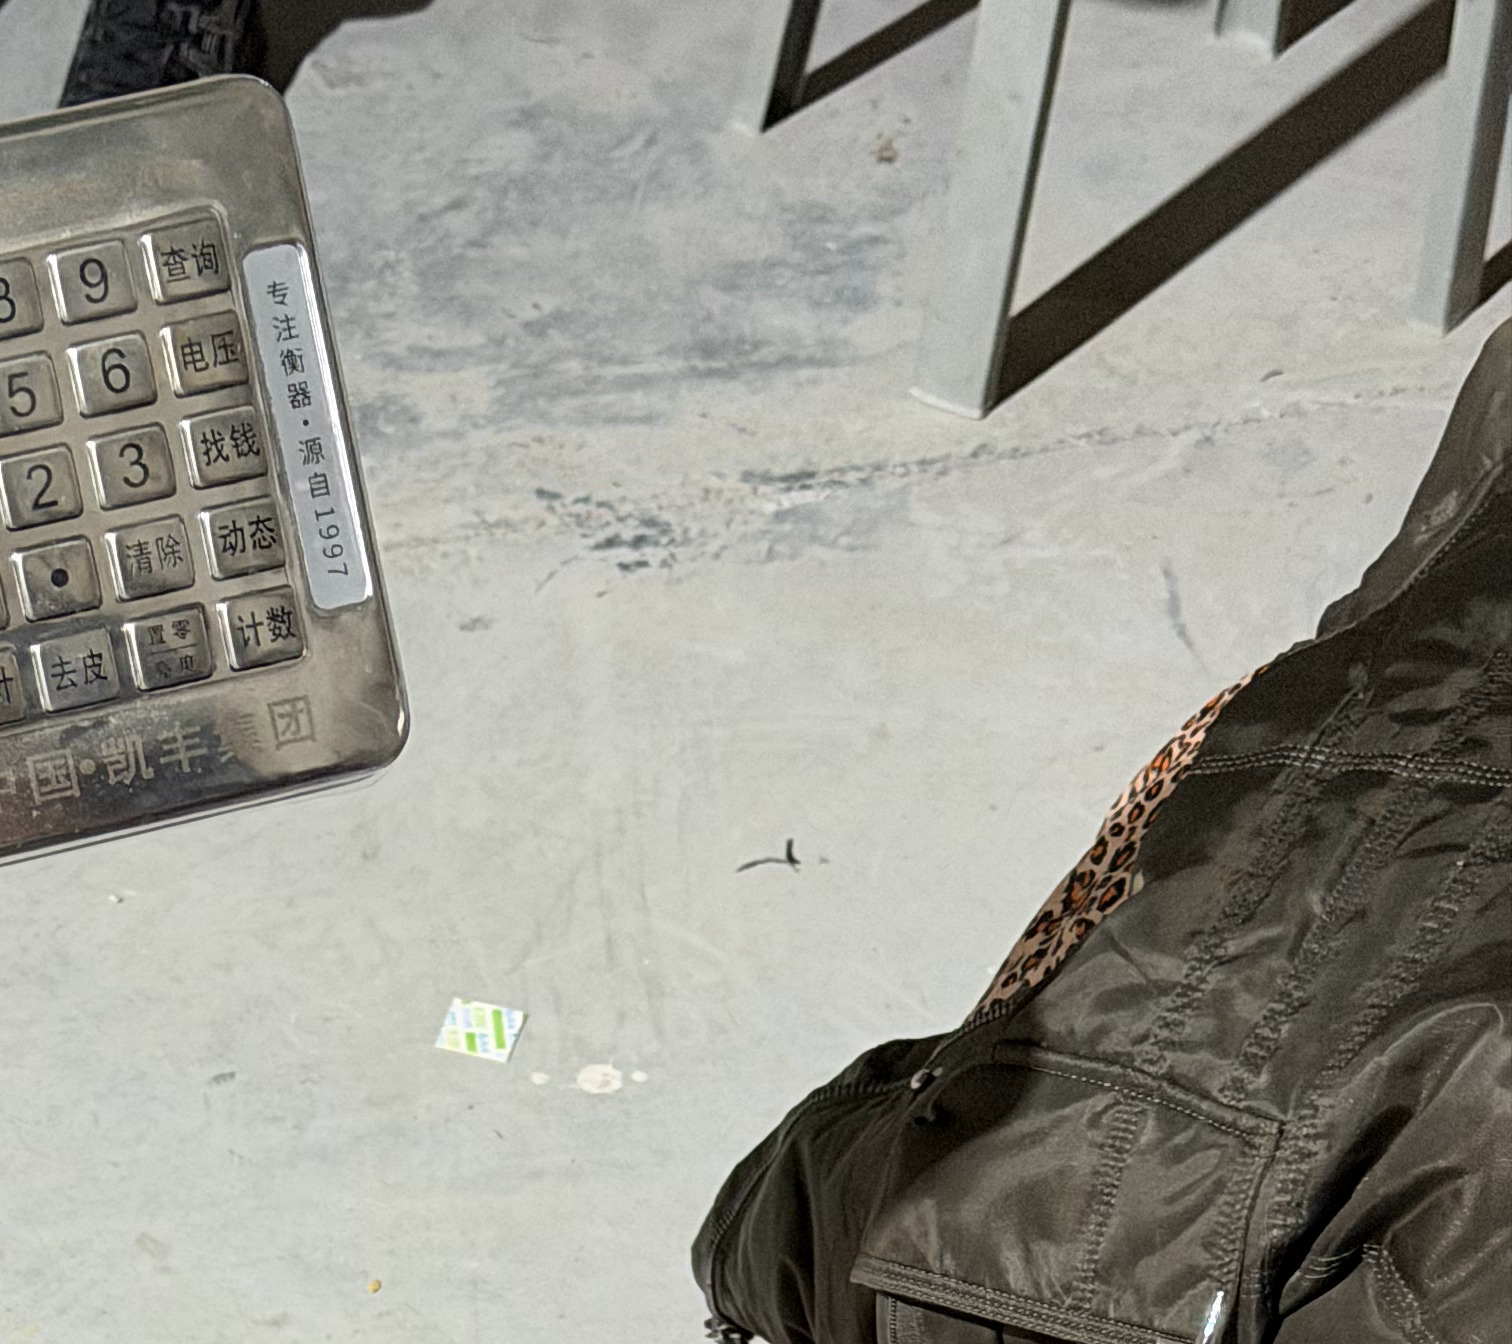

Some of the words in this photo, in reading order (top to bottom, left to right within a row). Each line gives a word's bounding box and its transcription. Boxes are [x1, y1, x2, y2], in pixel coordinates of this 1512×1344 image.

[78, 257, 110, 305] 9
[160, 238, 220, 284] 查询
[100, 347, 131, 395] 6
[179, 329, 239, 373] 电压
[6, 371, 37, 418] 5
[118, 442, 150, 489] 3
[199, 423, 261, 468] 找钱
[25, 463, 59, 512] 2
[125, 533, 185, 578] 清除
[217, 515, 278, 558] 动态
[236, 605, 297, 648] 计数
[50, 647, 109, 692] 去皮
